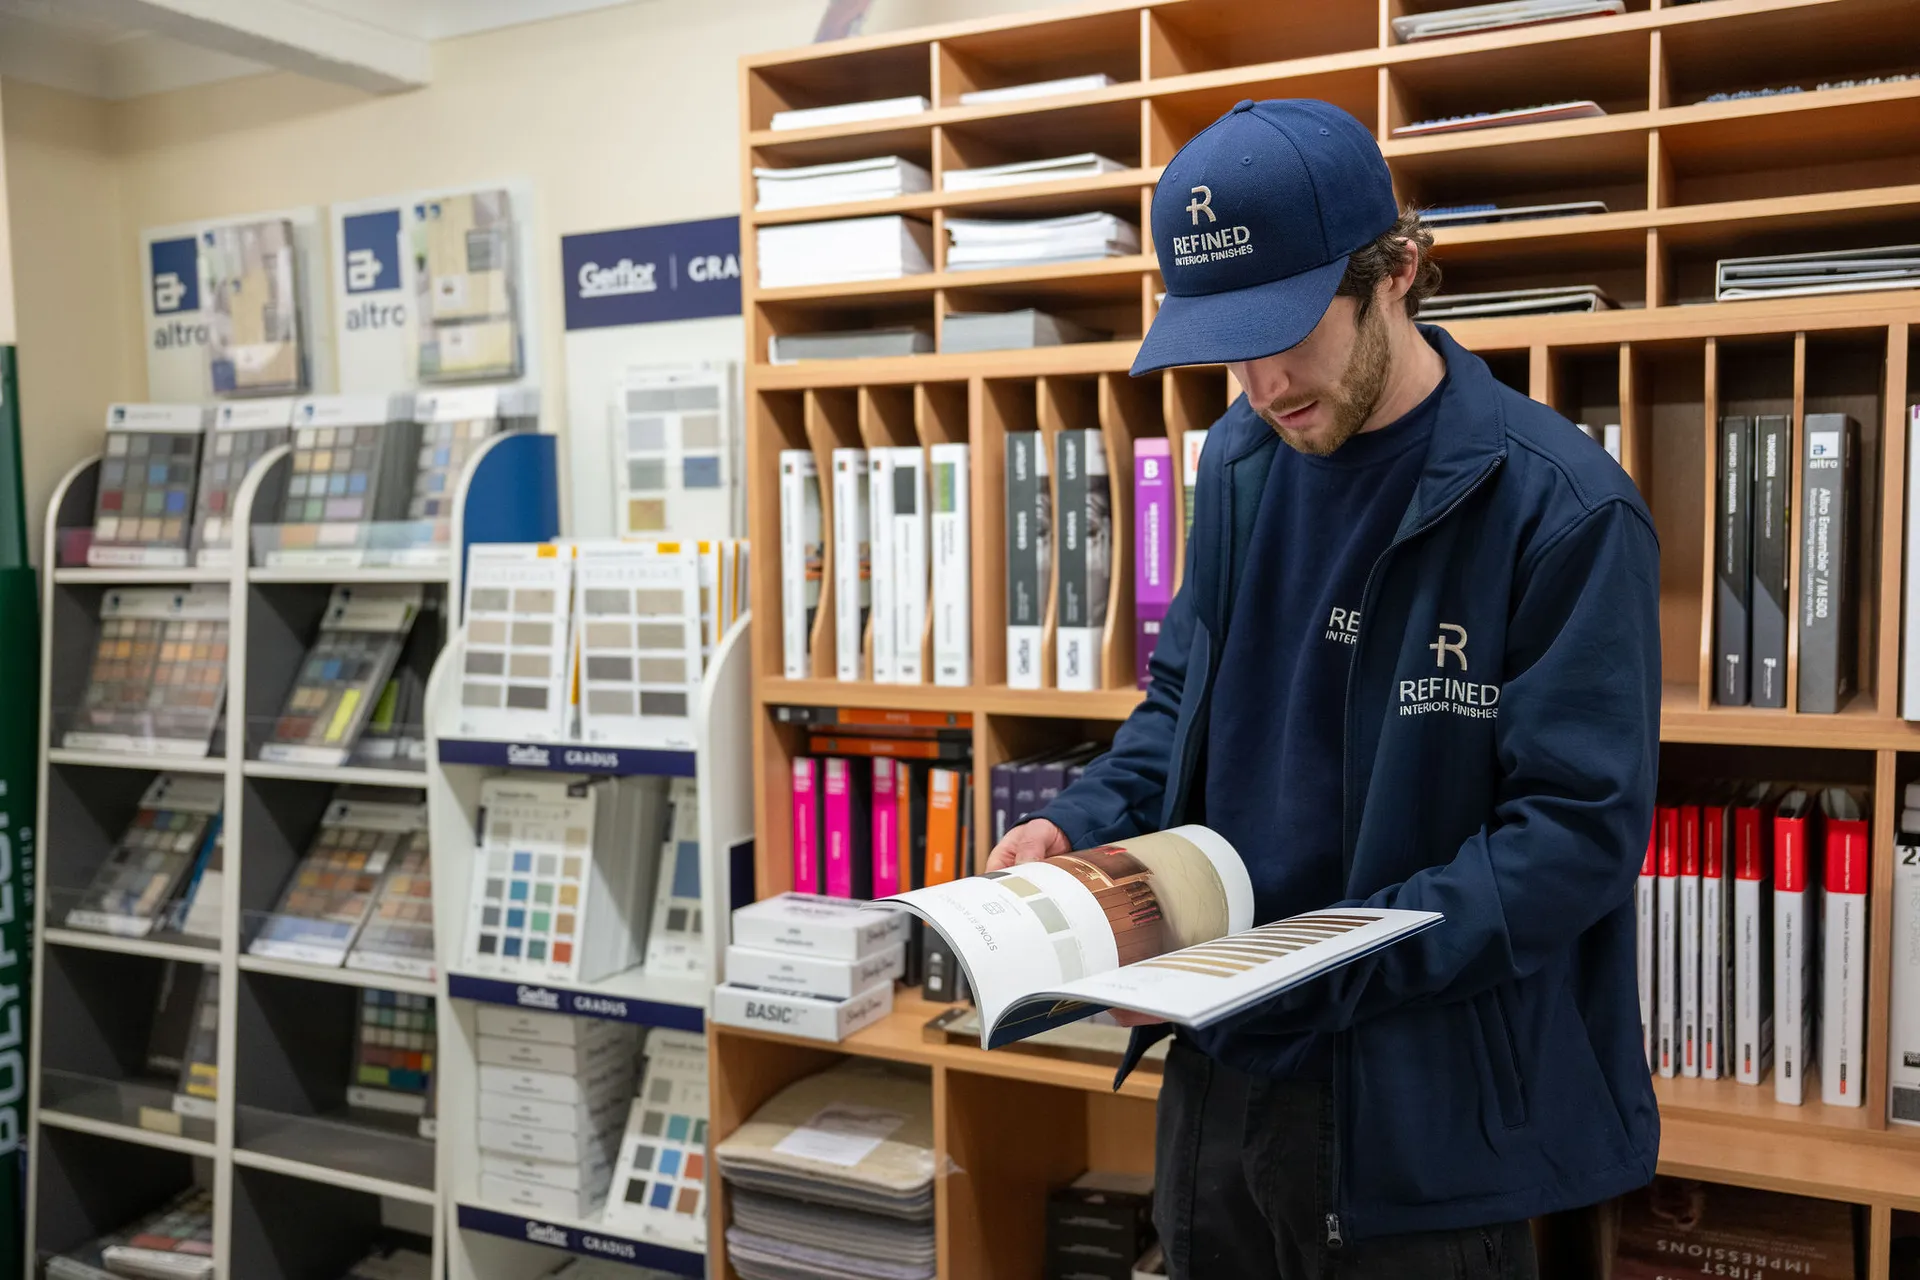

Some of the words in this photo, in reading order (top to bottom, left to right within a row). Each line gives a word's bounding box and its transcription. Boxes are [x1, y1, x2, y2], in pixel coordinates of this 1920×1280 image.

[1173, 225, 1251, 256] REFINED
[1175, 253, 1209, 267] INTERIOR
[1211, 244, 1254, 262] FINISHES
[578, 257, 657, 294] Gerflor
[687, 254, 741, 282] GRA
[1810, 459, 1838, 469] altro
[1819, 488, 1831, 515] Altro
[1400, 677, 1500, 706] REFINED
[1400, 701, 1450, 716] INTERIOR
[1452, 702, 1499, 719] FINISHES
[565, 748, 618, 768] GRADUS
[1902, 845, 1920, 866] 2
[975, 925, 998, 951] STONE
[574, 996, 627, 1016] GRADUS
[582, 1235, 635, 1258] GRADUS
[1656, 1239, 1811, 1275] IMPRESSIONS
[1702, 1262, 1763, 1280] FIRST
